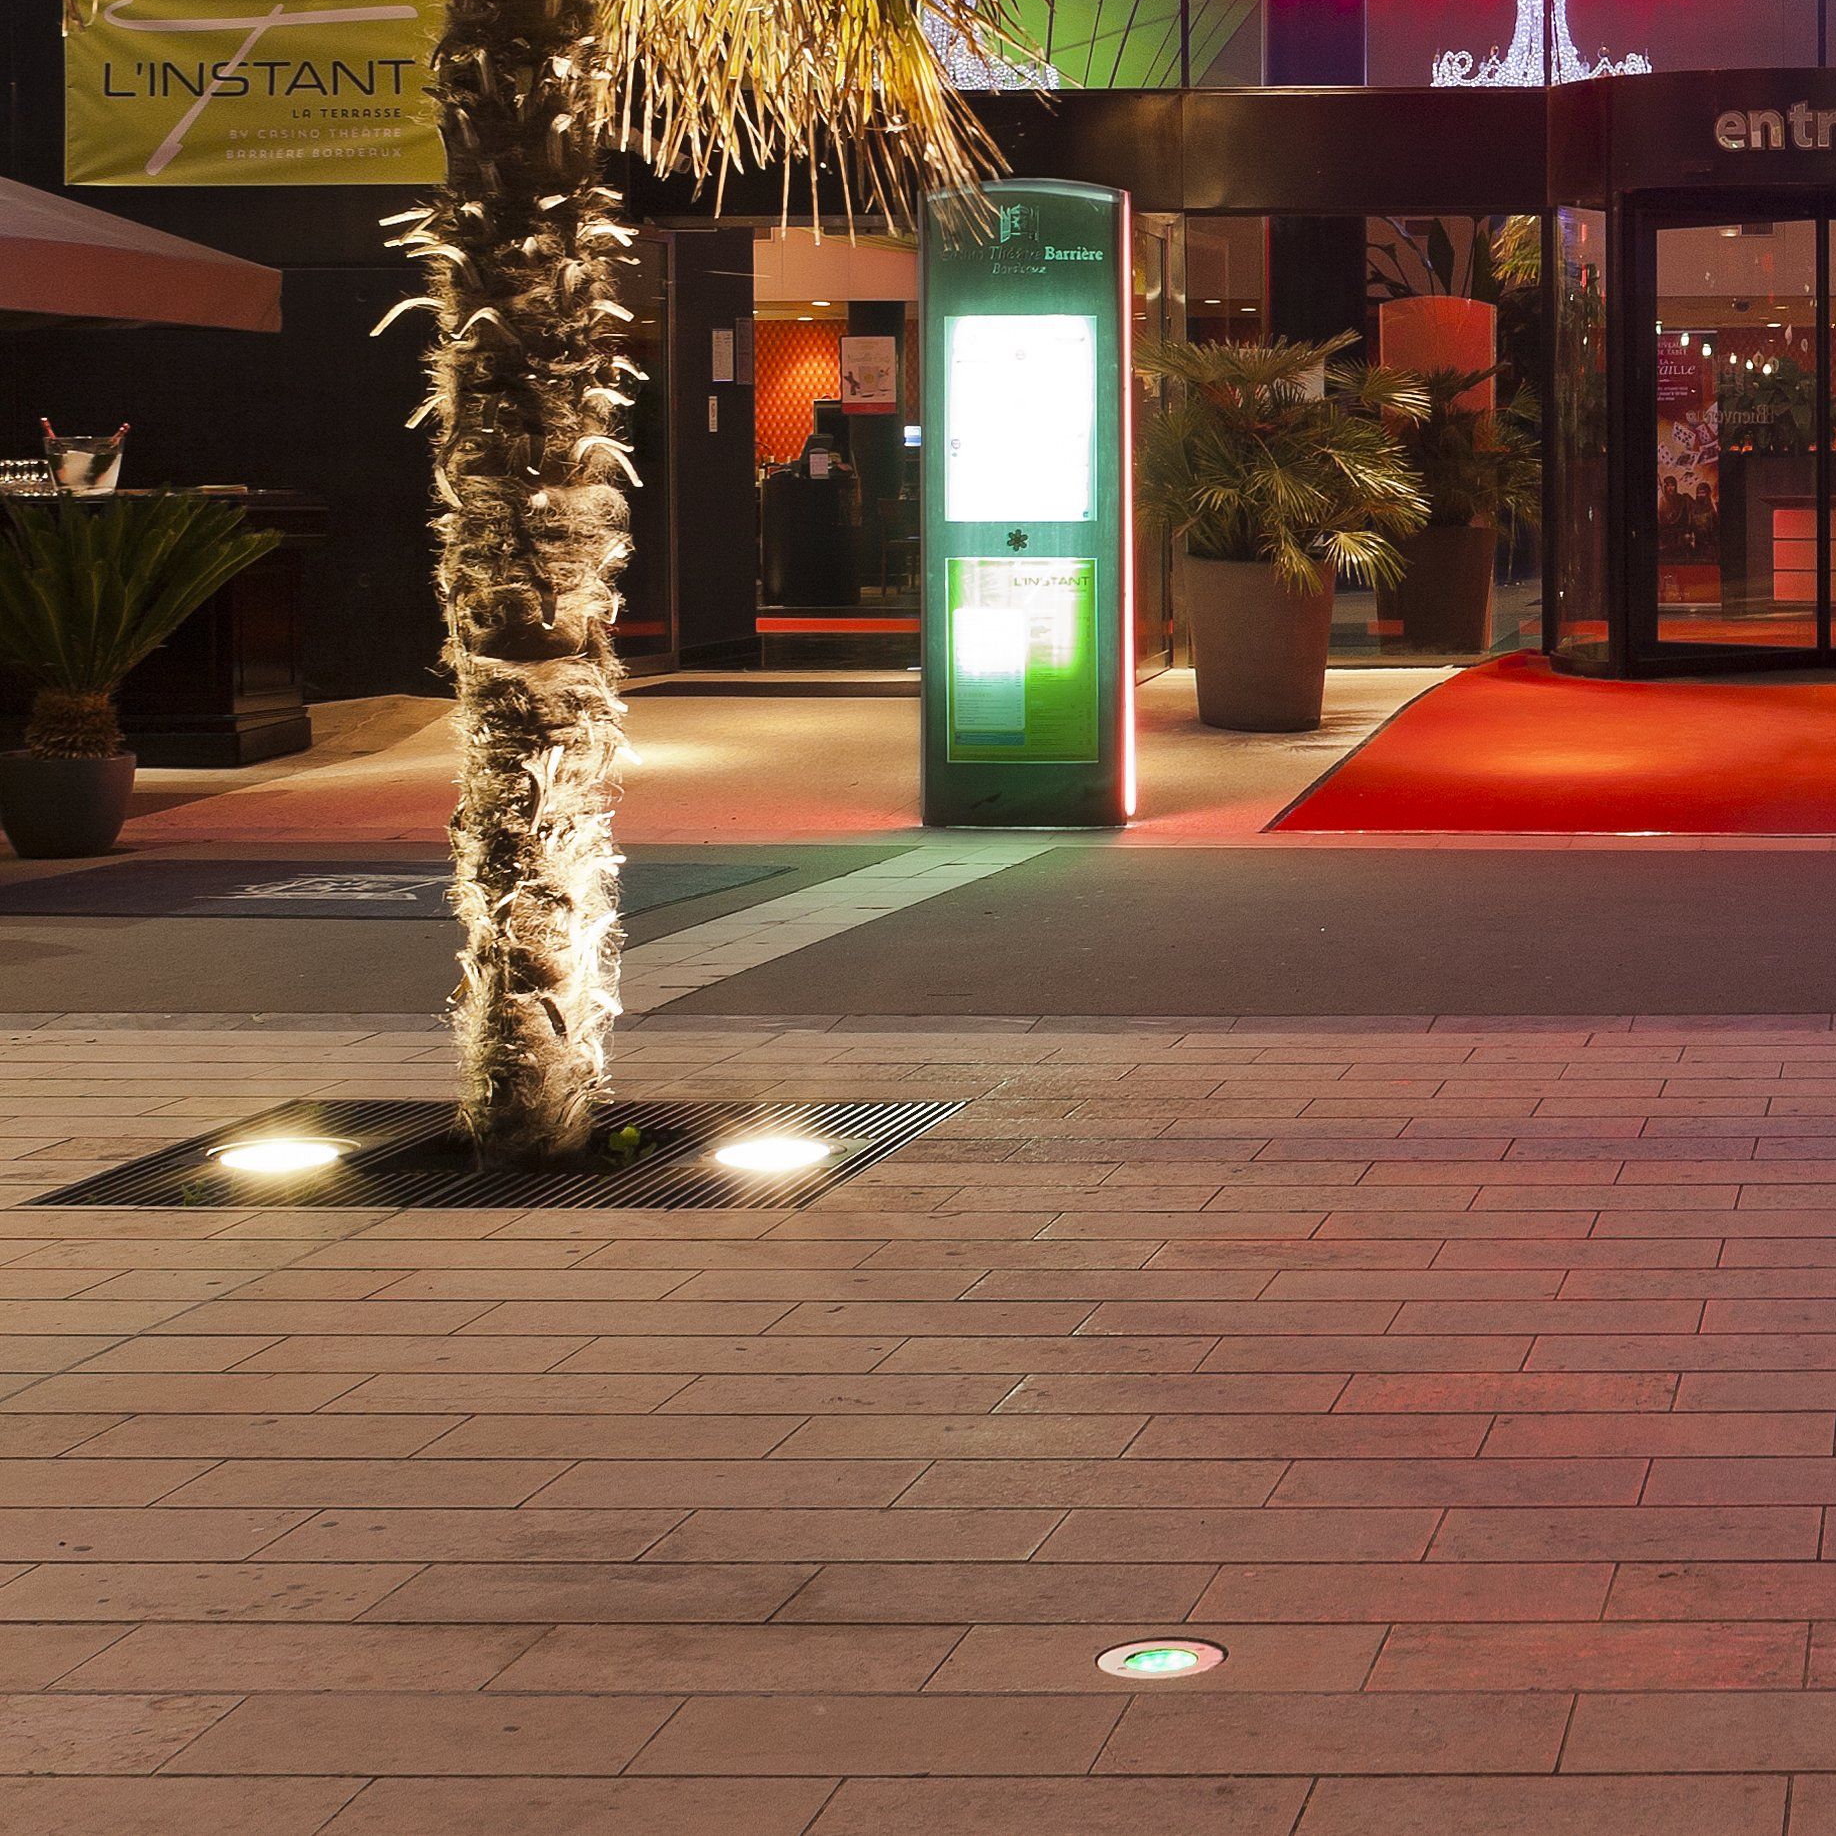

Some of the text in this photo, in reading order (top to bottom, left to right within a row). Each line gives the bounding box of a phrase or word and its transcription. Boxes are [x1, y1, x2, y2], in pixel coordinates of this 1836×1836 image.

[103, 58, 416, 98] L'INSTANT
[292, 108, 402, 119] LA TERRASSE
[258, 129, 321, 140] CASINO
[311, 147, 402, 159] BORDEAUX
[1044, 246, 1103, 261] Barrière
